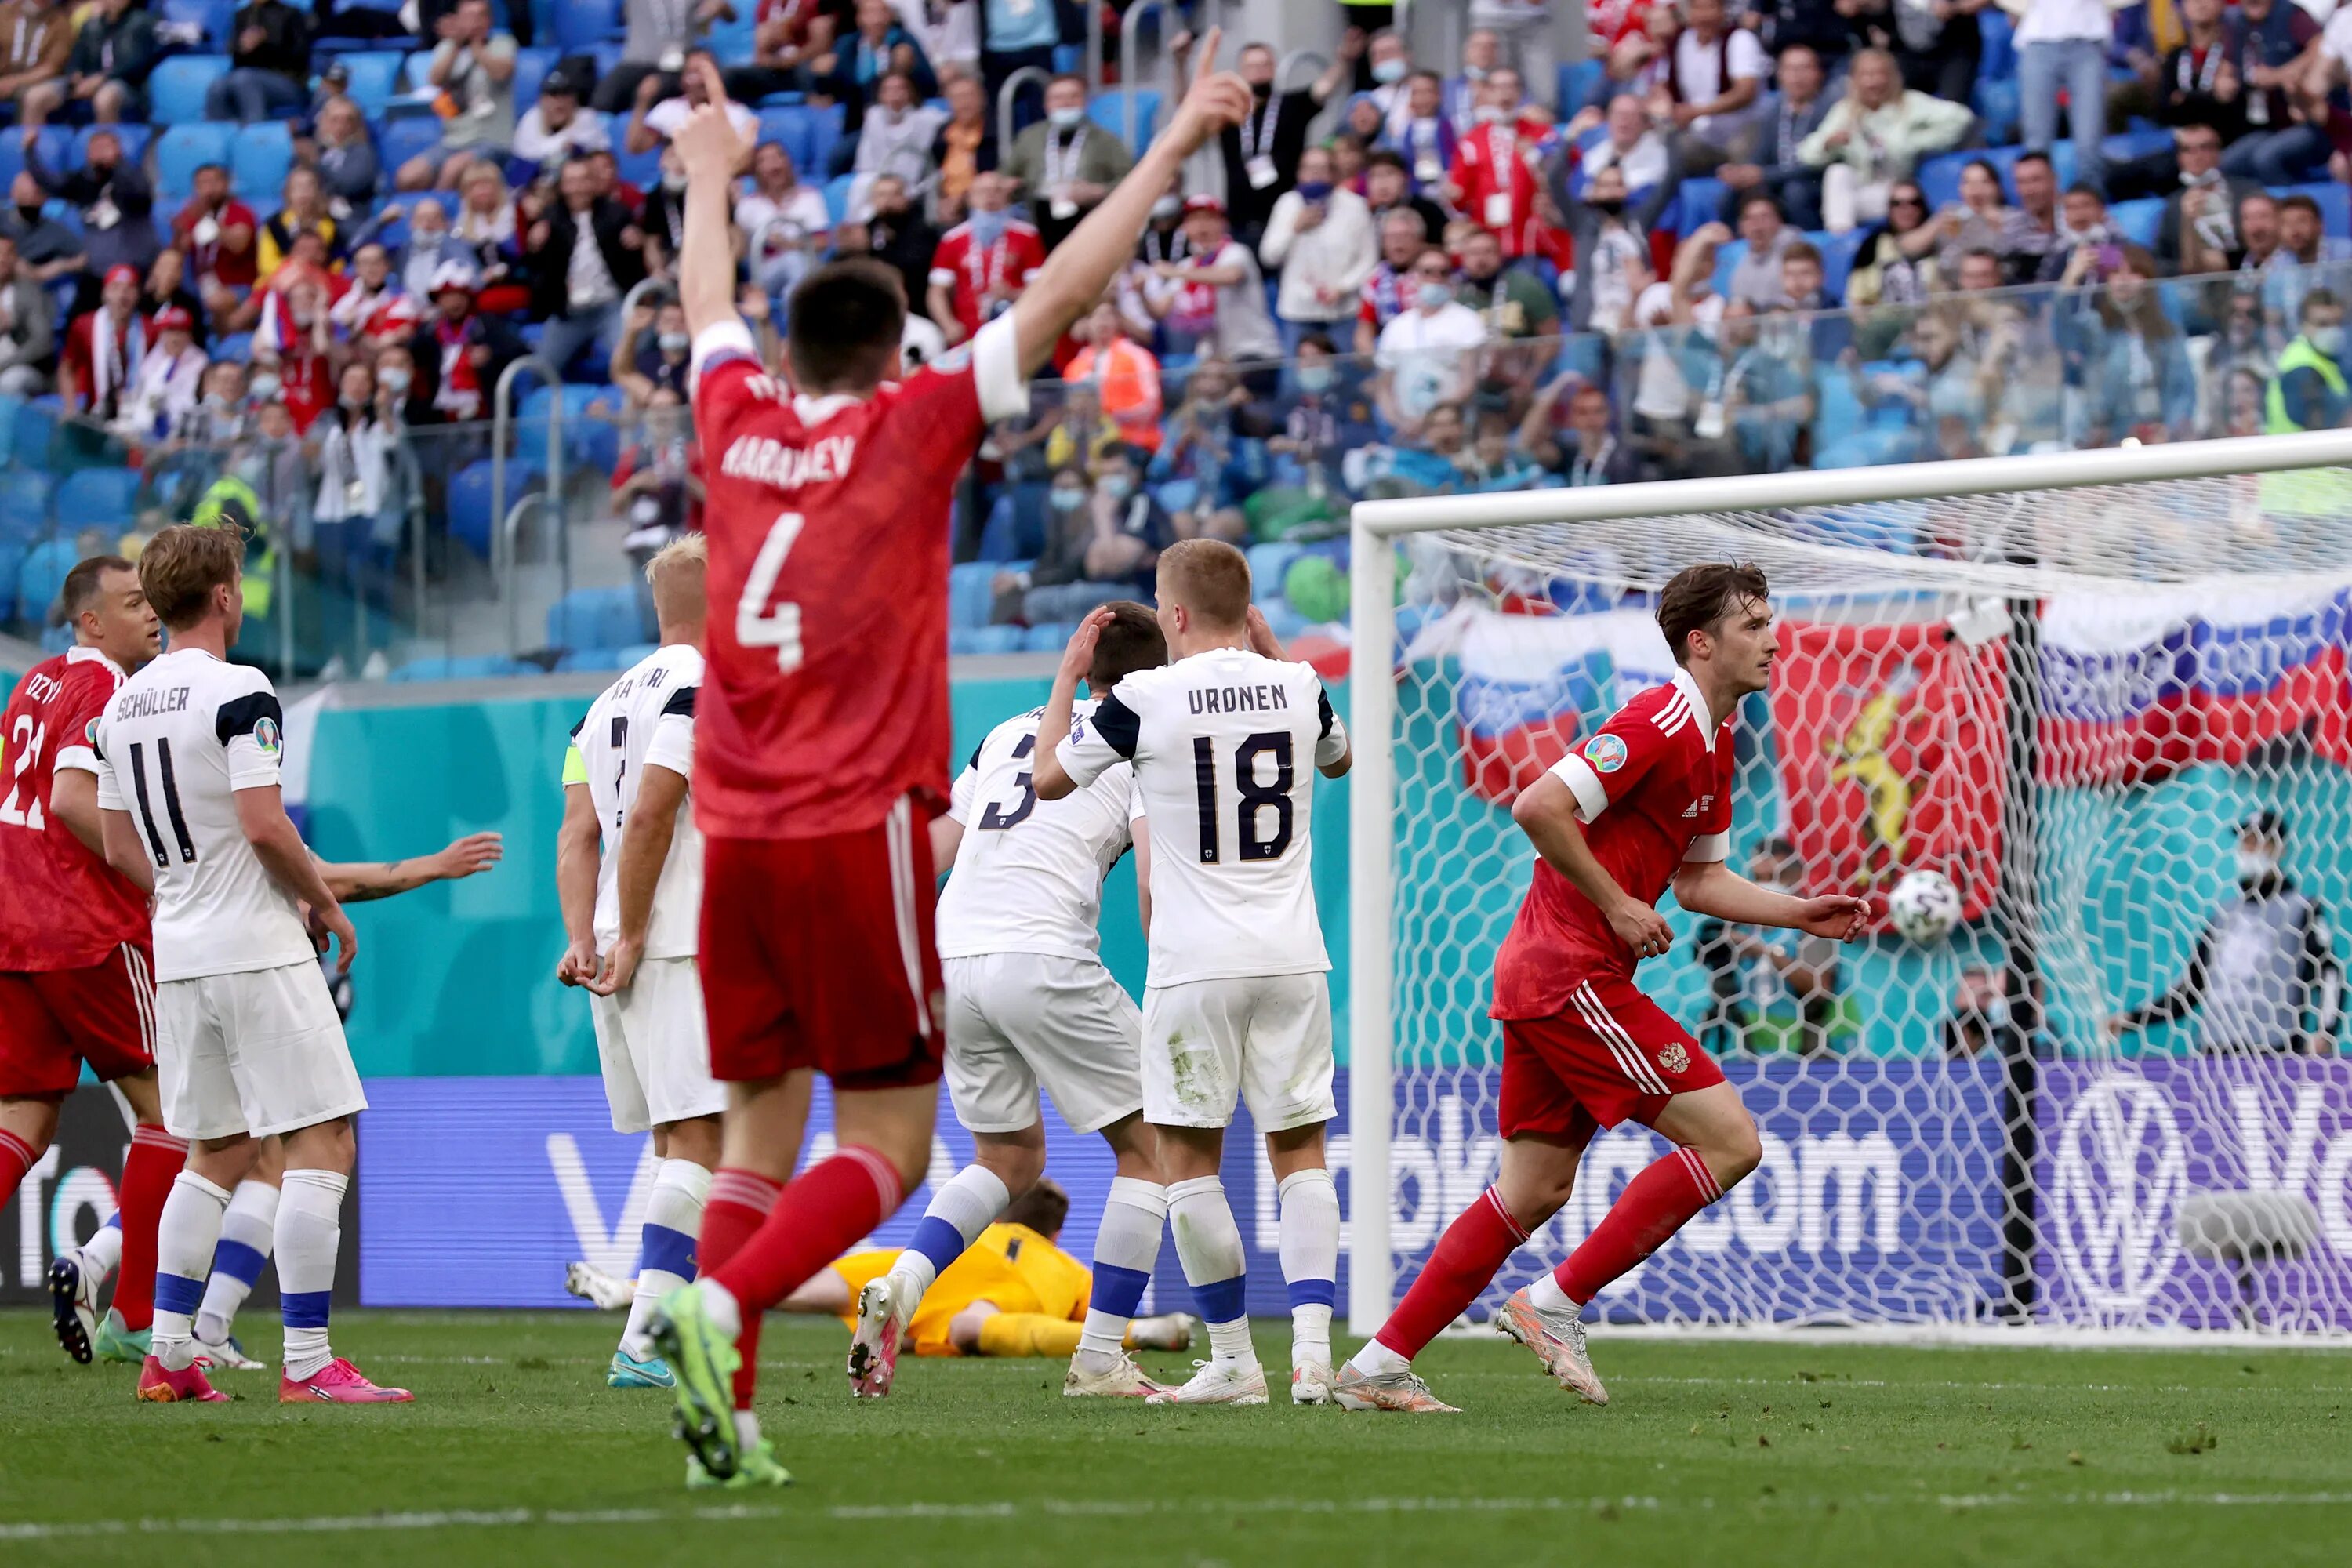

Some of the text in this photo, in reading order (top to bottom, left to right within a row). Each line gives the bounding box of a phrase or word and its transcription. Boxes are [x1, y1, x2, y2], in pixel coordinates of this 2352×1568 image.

[735, 512, 804, 677] 4
[116, 686, 190, 722] SCHÜLLER
[1188, 684, 1287, 714] URONEN
[0, 713, 45, 831] 21
[130, 736, 197, 868] 11
[978, 733, 1036, 830] 3
[1193, 731, 1294, 865] 18
